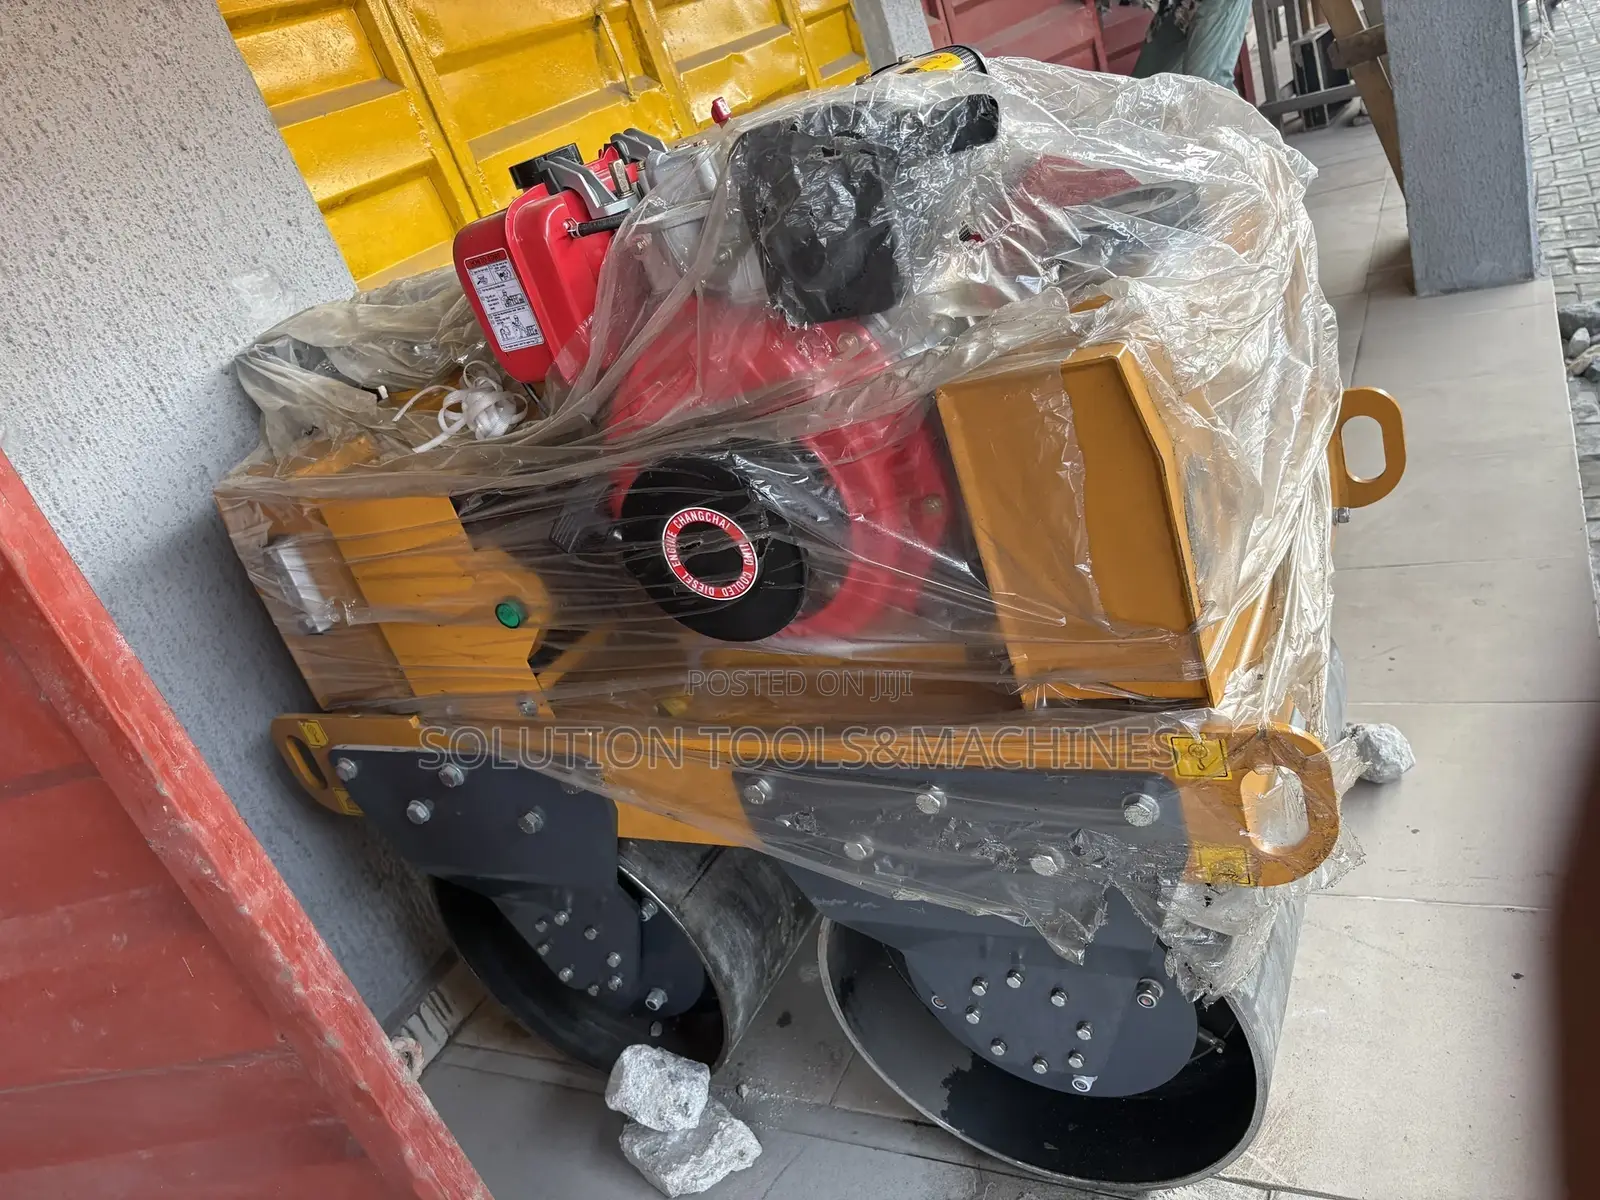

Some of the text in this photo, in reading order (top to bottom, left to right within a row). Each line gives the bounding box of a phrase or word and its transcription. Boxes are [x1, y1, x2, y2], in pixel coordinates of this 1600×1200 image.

[673, 510, 730, 530] CHANGCHAI
[681, 571, 715, 597] DIESEL
[721, 571, 752, 597] COOLED
